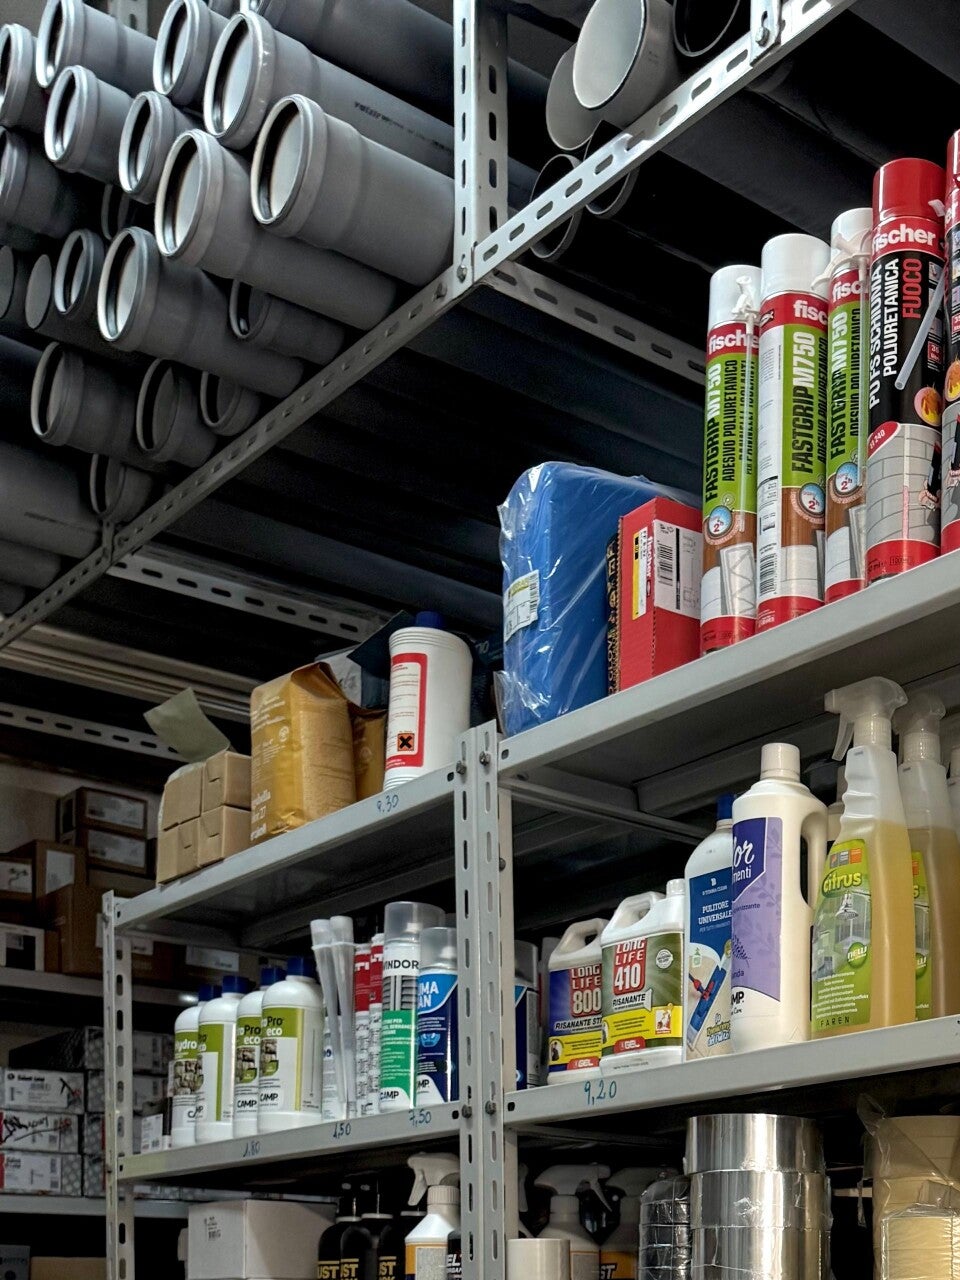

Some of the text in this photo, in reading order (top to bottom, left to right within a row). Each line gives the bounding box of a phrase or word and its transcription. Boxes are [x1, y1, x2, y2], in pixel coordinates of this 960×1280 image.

[873, 223, 937, 254] fischer
[903, 258, 922, 318] FUOCO
[793, 300, 828, 323] fisc
[883, 258, 899, 377] POLIURETANICA
[706, 363, 722, 420] M750
[791, 331, 815, 474] FASTGRIP M750
[822, 871, 862, 893] citrus
[702, 901, 729, 914] PULITORE
[698, 910, 733, 926] UNIVERSALE
[615, 939, 645, 954] LONG
[615, 950, 644, 965] LIFE
[571, 964, 600, 979] LONG
[614, 964, 641, 991] 410
[572, 976, 600, 990] LIFE
[573, 988, 600, 1013] 800
[612, 993, 646, 1008] RISANANTE
[554, 1019, 591, 1031] RISANANTE
[820, 1016, 851, 1028] FAREN
[266, 1027, 283, 1036] eco
[243, 1035, 261, 1045] eco
[583, 1079, 618, 1106] 9,20
[237, 1099, 257, 1109] CAMP
